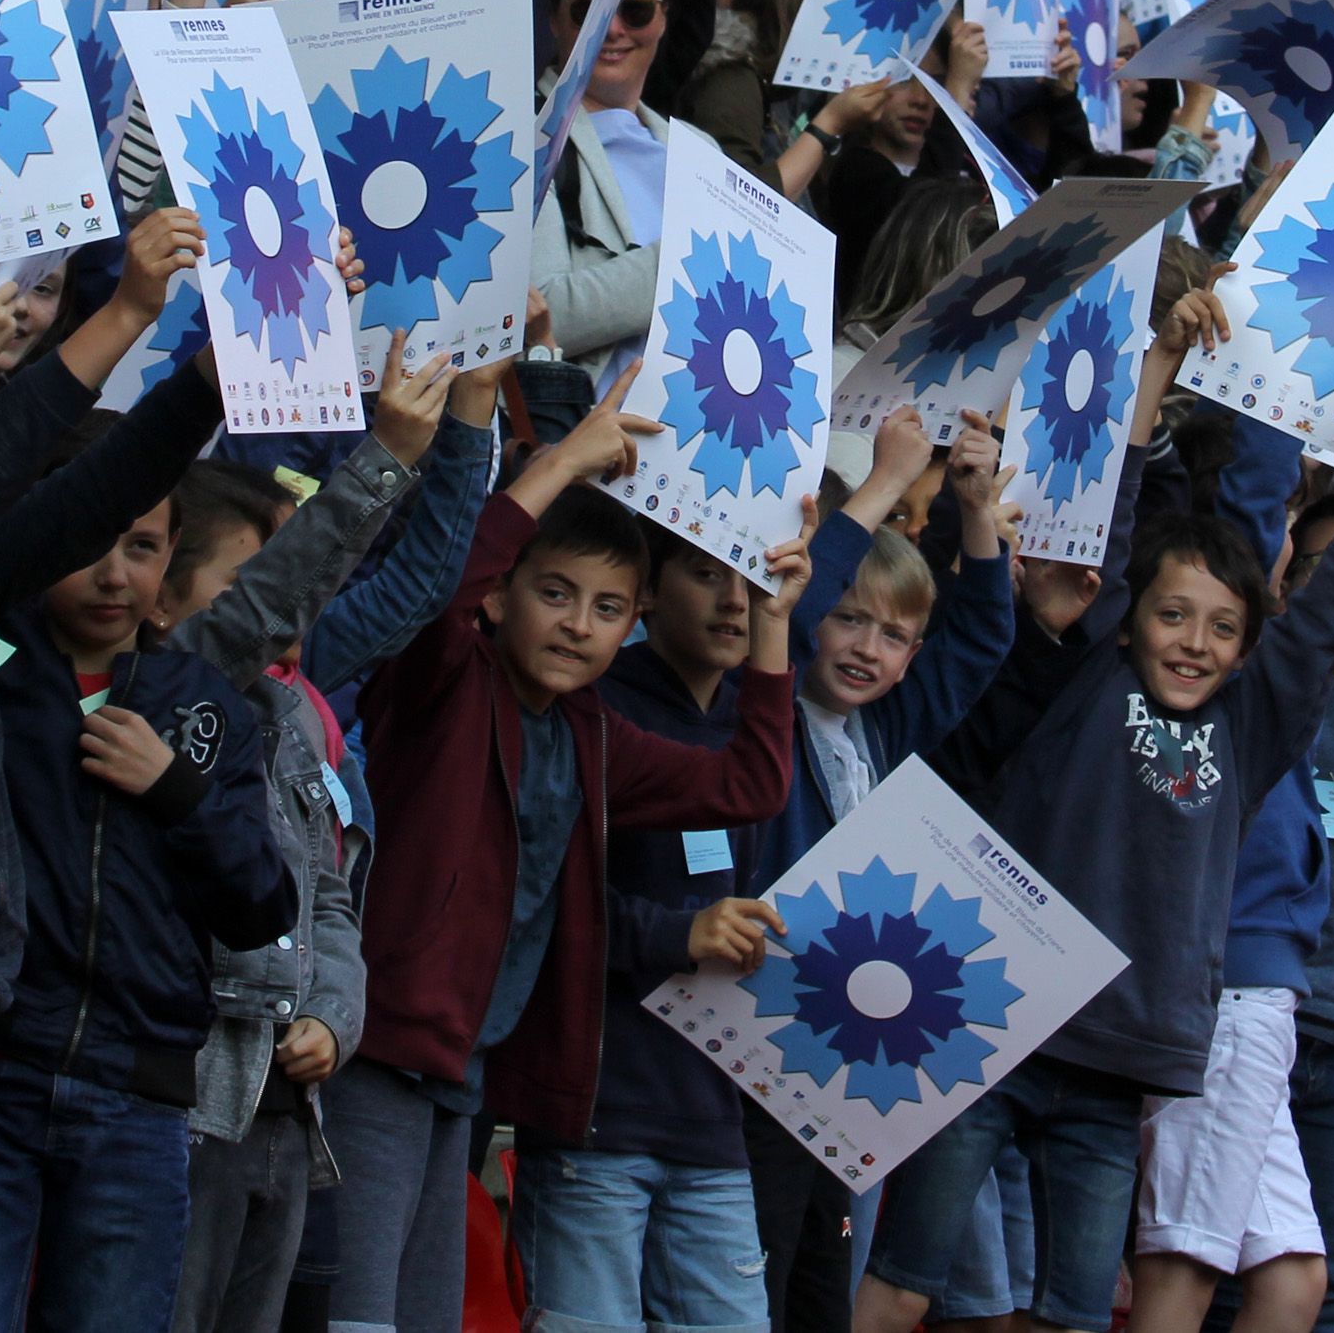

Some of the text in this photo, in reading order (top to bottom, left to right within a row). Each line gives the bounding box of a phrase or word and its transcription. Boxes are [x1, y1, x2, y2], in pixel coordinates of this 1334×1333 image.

[363, 12, 380, 20] VIVRE
[394, 2, 434, 15] INTELLIGENCE
[179, 20, 225, 34] rennes
[739, 178, 779, 214] rennes
[990, 850, 1048, 905] rennes
